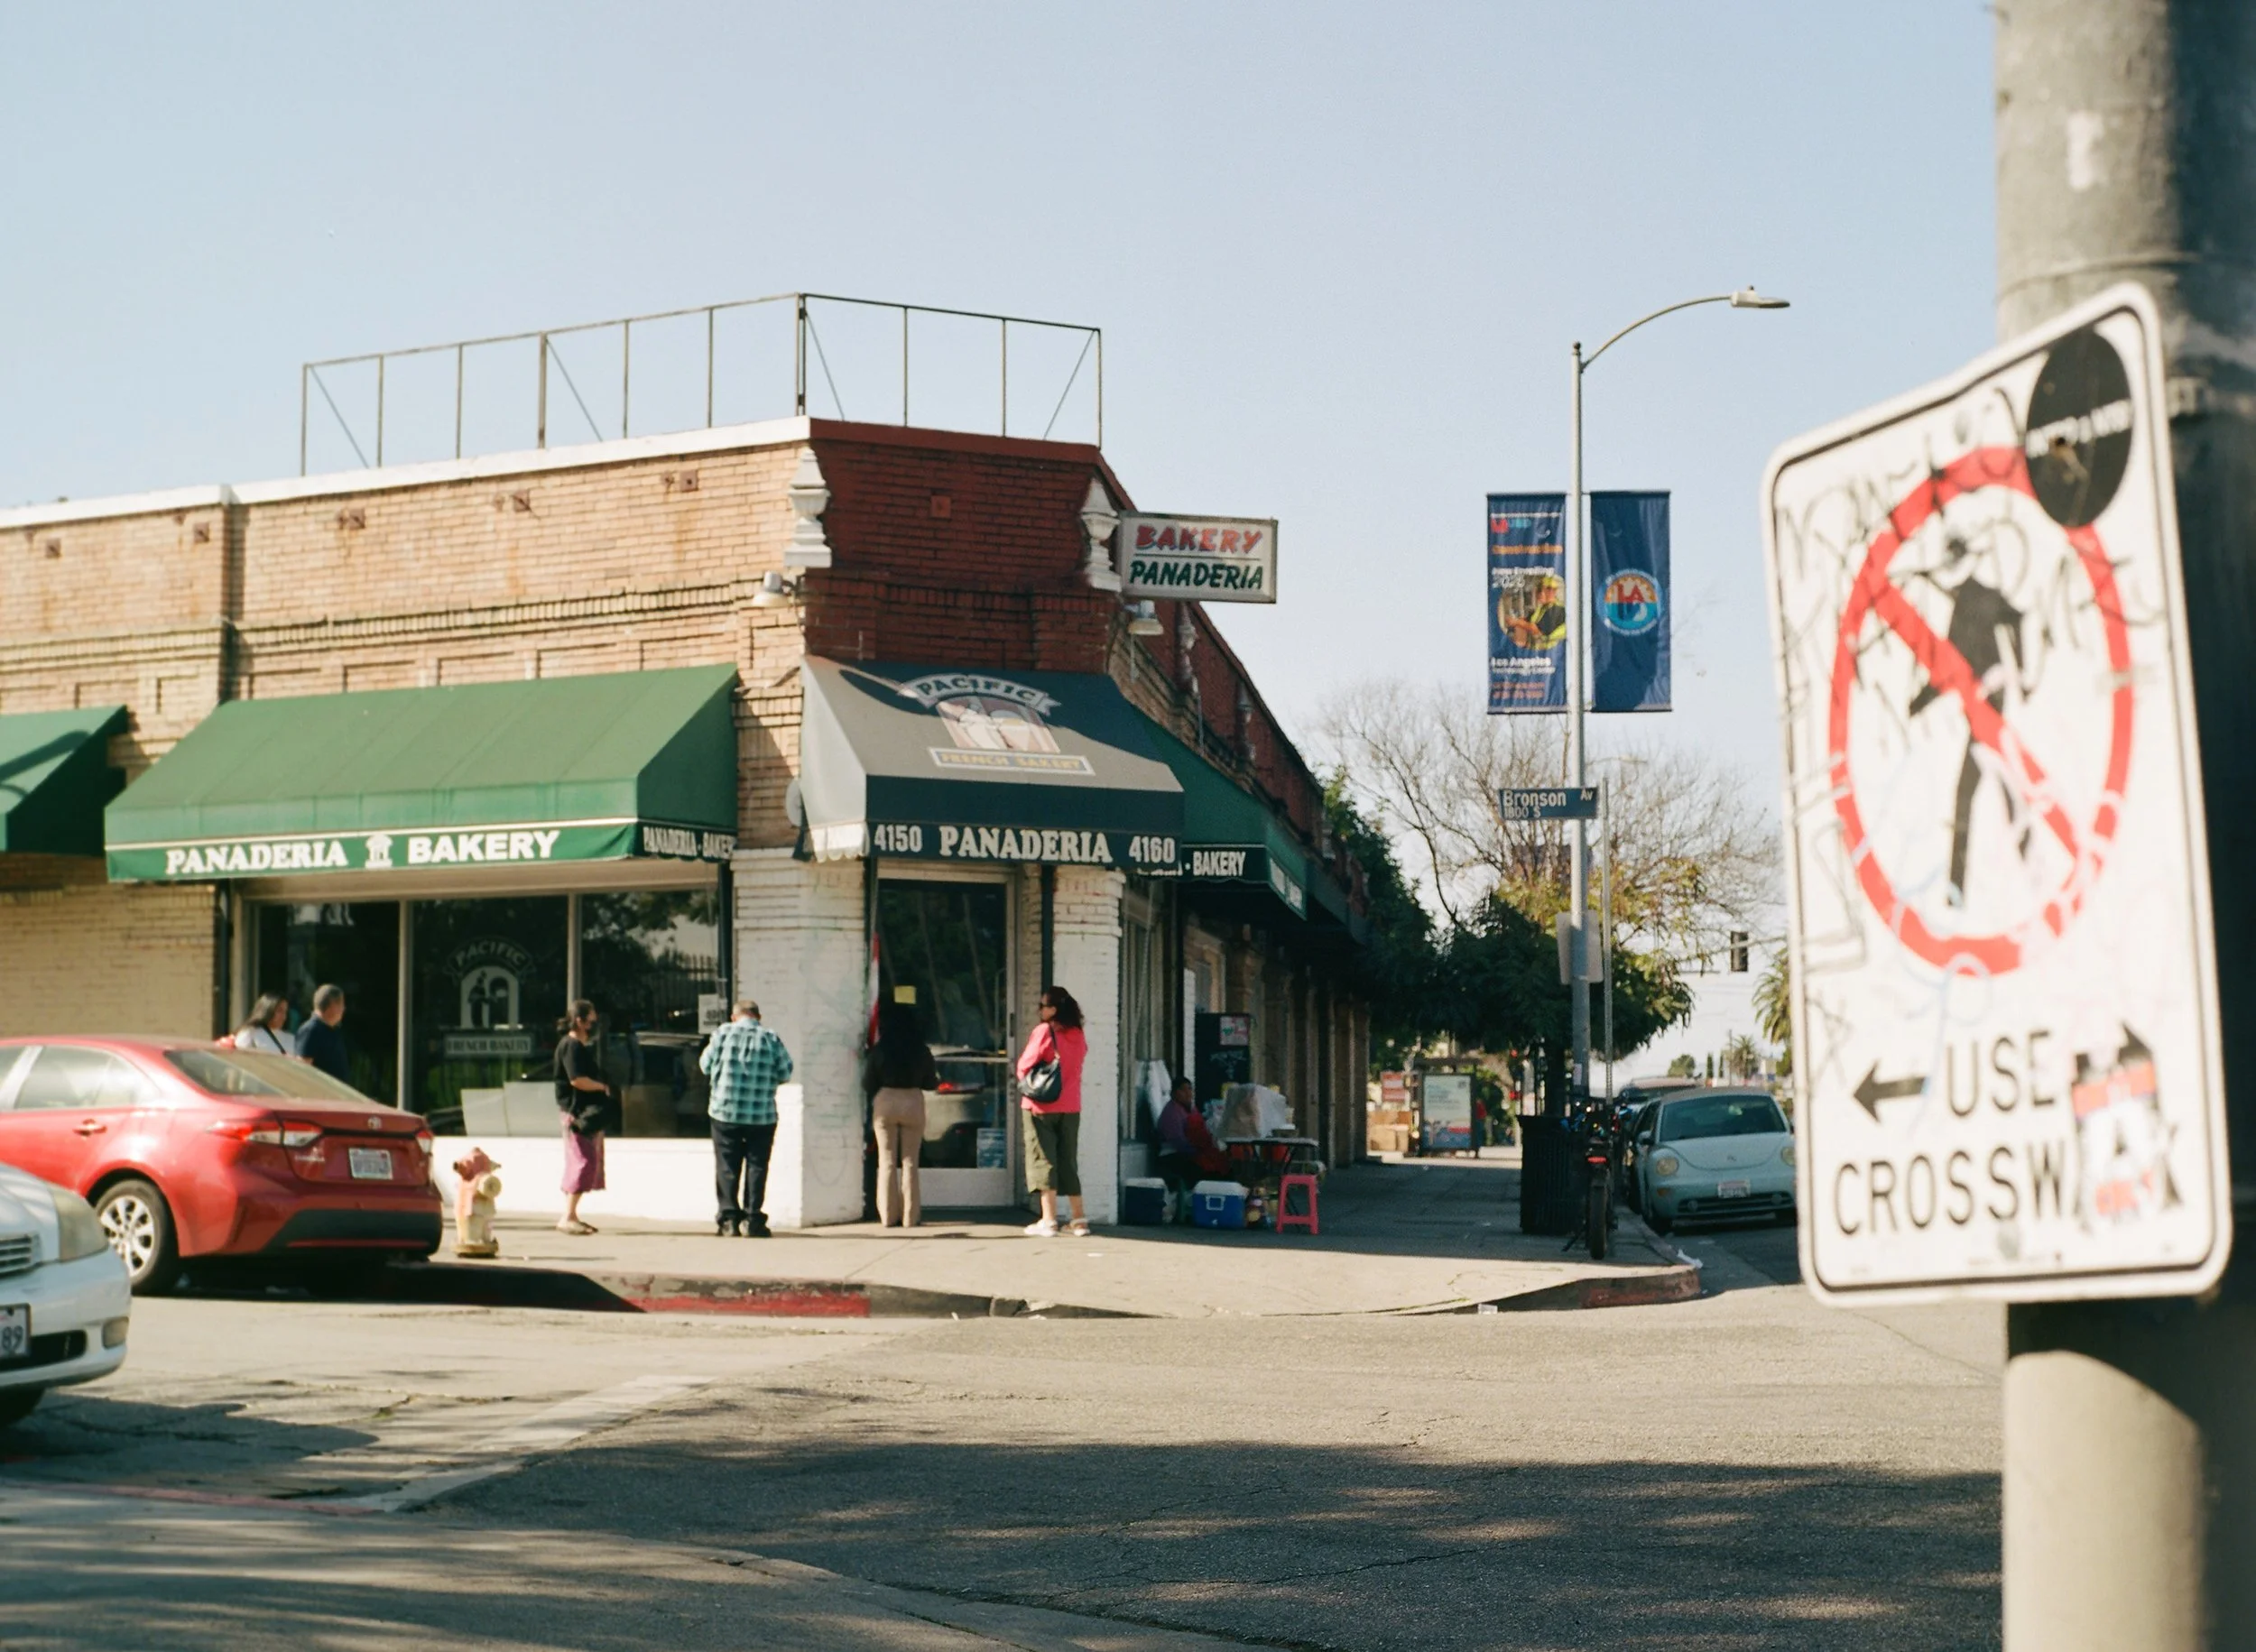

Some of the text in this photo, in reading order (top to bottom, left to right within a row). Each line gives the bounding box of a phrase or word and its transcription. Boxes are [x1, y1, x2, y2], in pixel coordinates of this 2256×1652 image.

[1136, 525, 1262, 554] BAKERY
[1130, 560, 1263, 589] PANADERIA
[1510, 656, 1552, 669] Angeles
[916, 677, 1036, 701] PACIFIC
[1502, 788, 1594, 807] Bronson Av
[1533, 805, 1541, 818] S
[166, 830, 559, 874] PANADERIA BAKERY
[874, 825, 1176, 864] 4150 PANADERIA 4160
[1192, 851, 1246, 877] BAKERY
[454, 939, 526, 968] PACIFIC
[1946, 1029, 2056, 1117] USE
